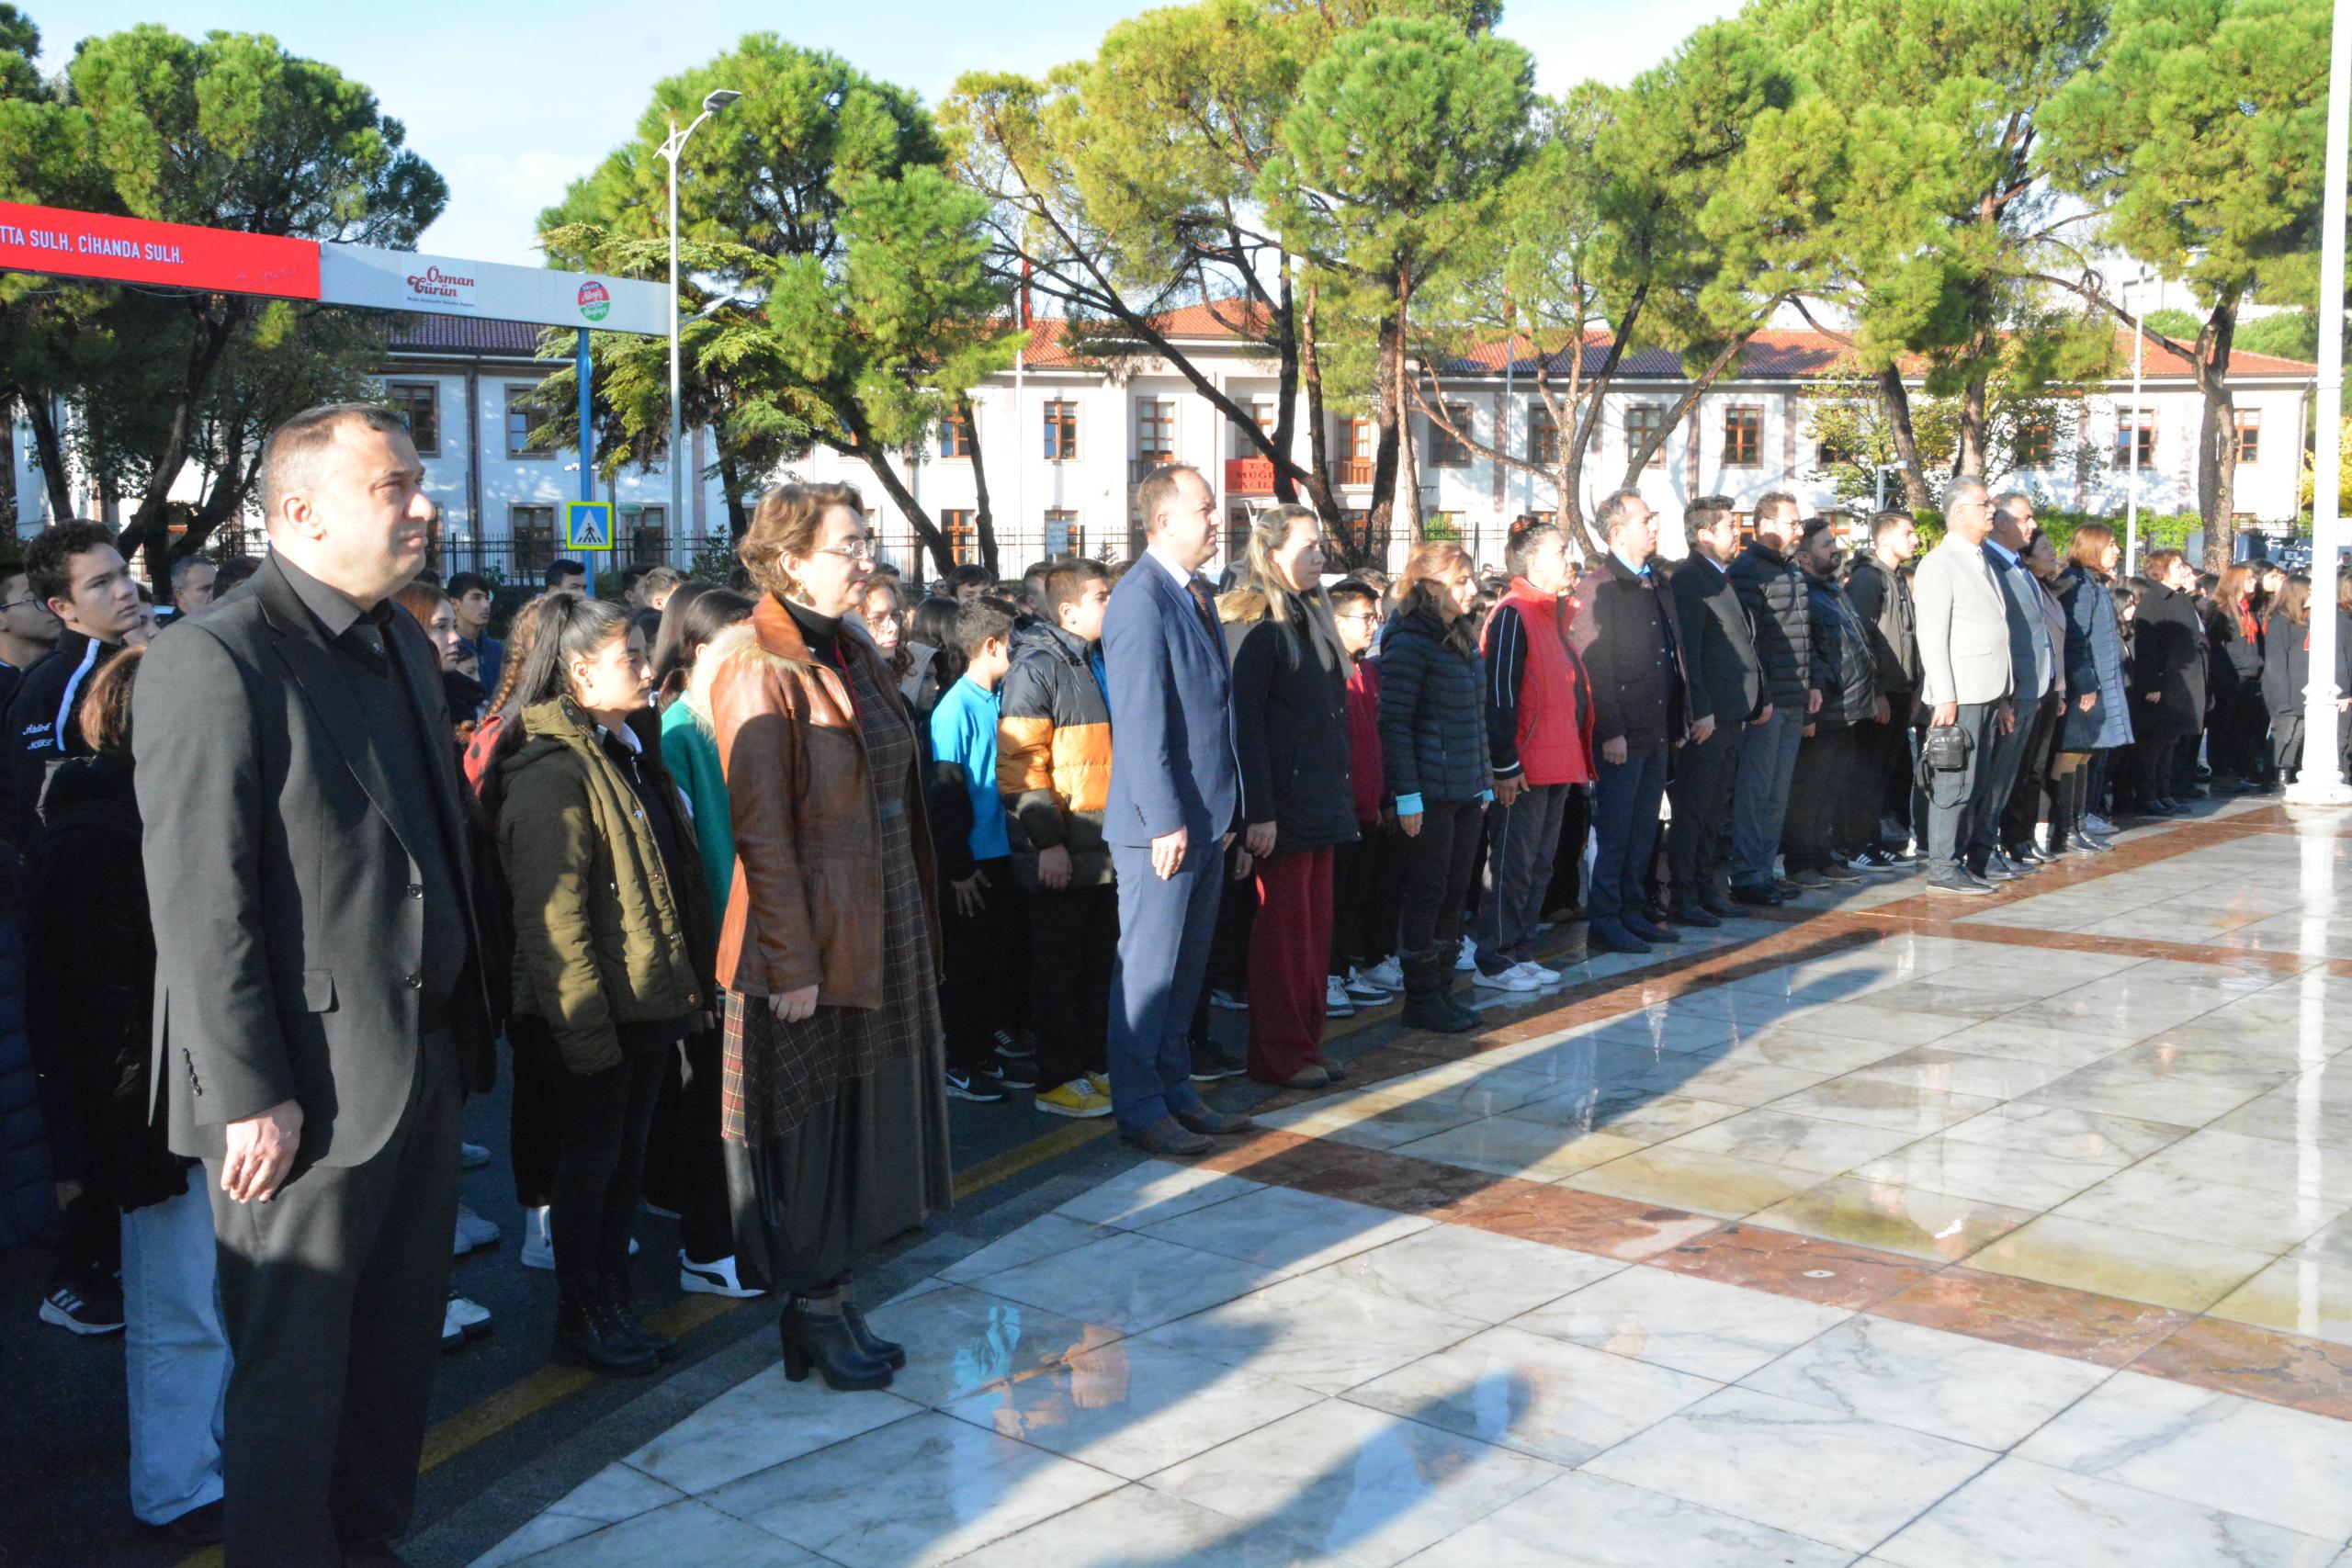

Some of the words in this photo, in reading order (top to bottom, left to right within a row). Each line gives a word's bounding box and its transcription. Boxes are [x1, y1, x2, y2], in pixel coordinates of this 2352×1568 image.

[29, 230, 74, 252] SULH.
[78, 232, 141, 259] CİHANDA
[144, 243, 185, 264] SULH.
[407, 275, 458, 297] Gürün
[426, 265, 475, 287] Osman
